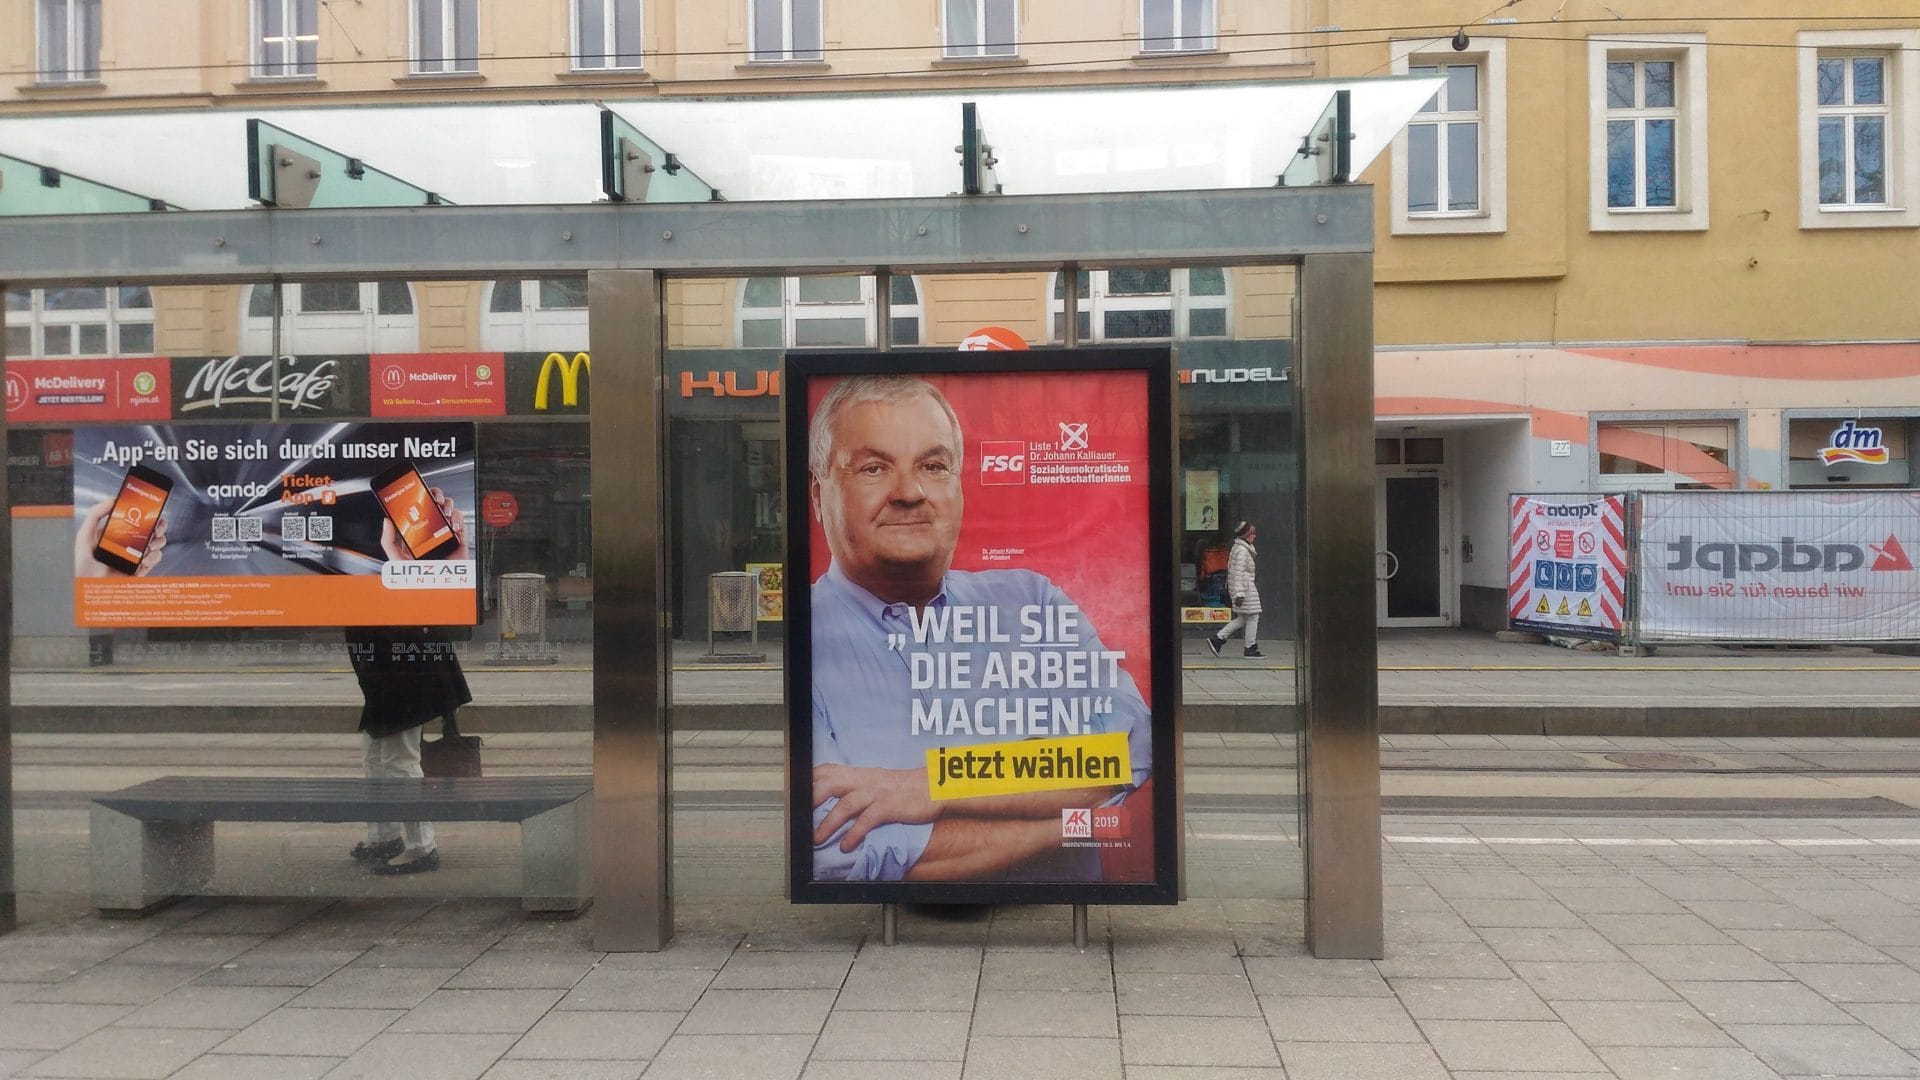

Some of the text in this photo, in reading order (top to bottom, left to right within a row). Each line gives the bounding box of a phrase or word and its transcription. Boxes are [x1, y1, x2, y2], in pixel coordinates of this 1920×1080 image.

[35, 376, 105, 390] McDelivery
[183, 355, 340, 410] McCafé
[409, 372, 457, 382] McDelivery
[1835, 420, 1882, 450] dm
[186, 440, 224, 461] Sie
[227, 439, 268, 460] sich
[279, 438, 336, 460] durch
[342, 442, 398, 459] unser
[404, 437, 457, 458] Netz!
[1030, 441, 1059, 450] Liste 1
[1030, 451, 1116, 460] Dr. Johann Kalliauer
[982, 456, 1024, 472] FSG
[1030, 464, 1129, 475] Sozialdemokratische
[281, 474, 336, 488] Ticket-
[207, 481, 268, 500] qando
[281, 490, 315, 506] App
[1547, 503, 1598, 519] adapt
[391, 565, 467, 576] LINZ AG
[1020, 605, 1079, 643] SIE
[911, 650, 1125, 689] DIE ARBEIT
[938, 747, 1120, 787] jetzt wählen
[1065, 811, 1088, 825] AK
[1094, 816, 1119, 828] 2019
[1064, 826, 1089, 835] WAHL
